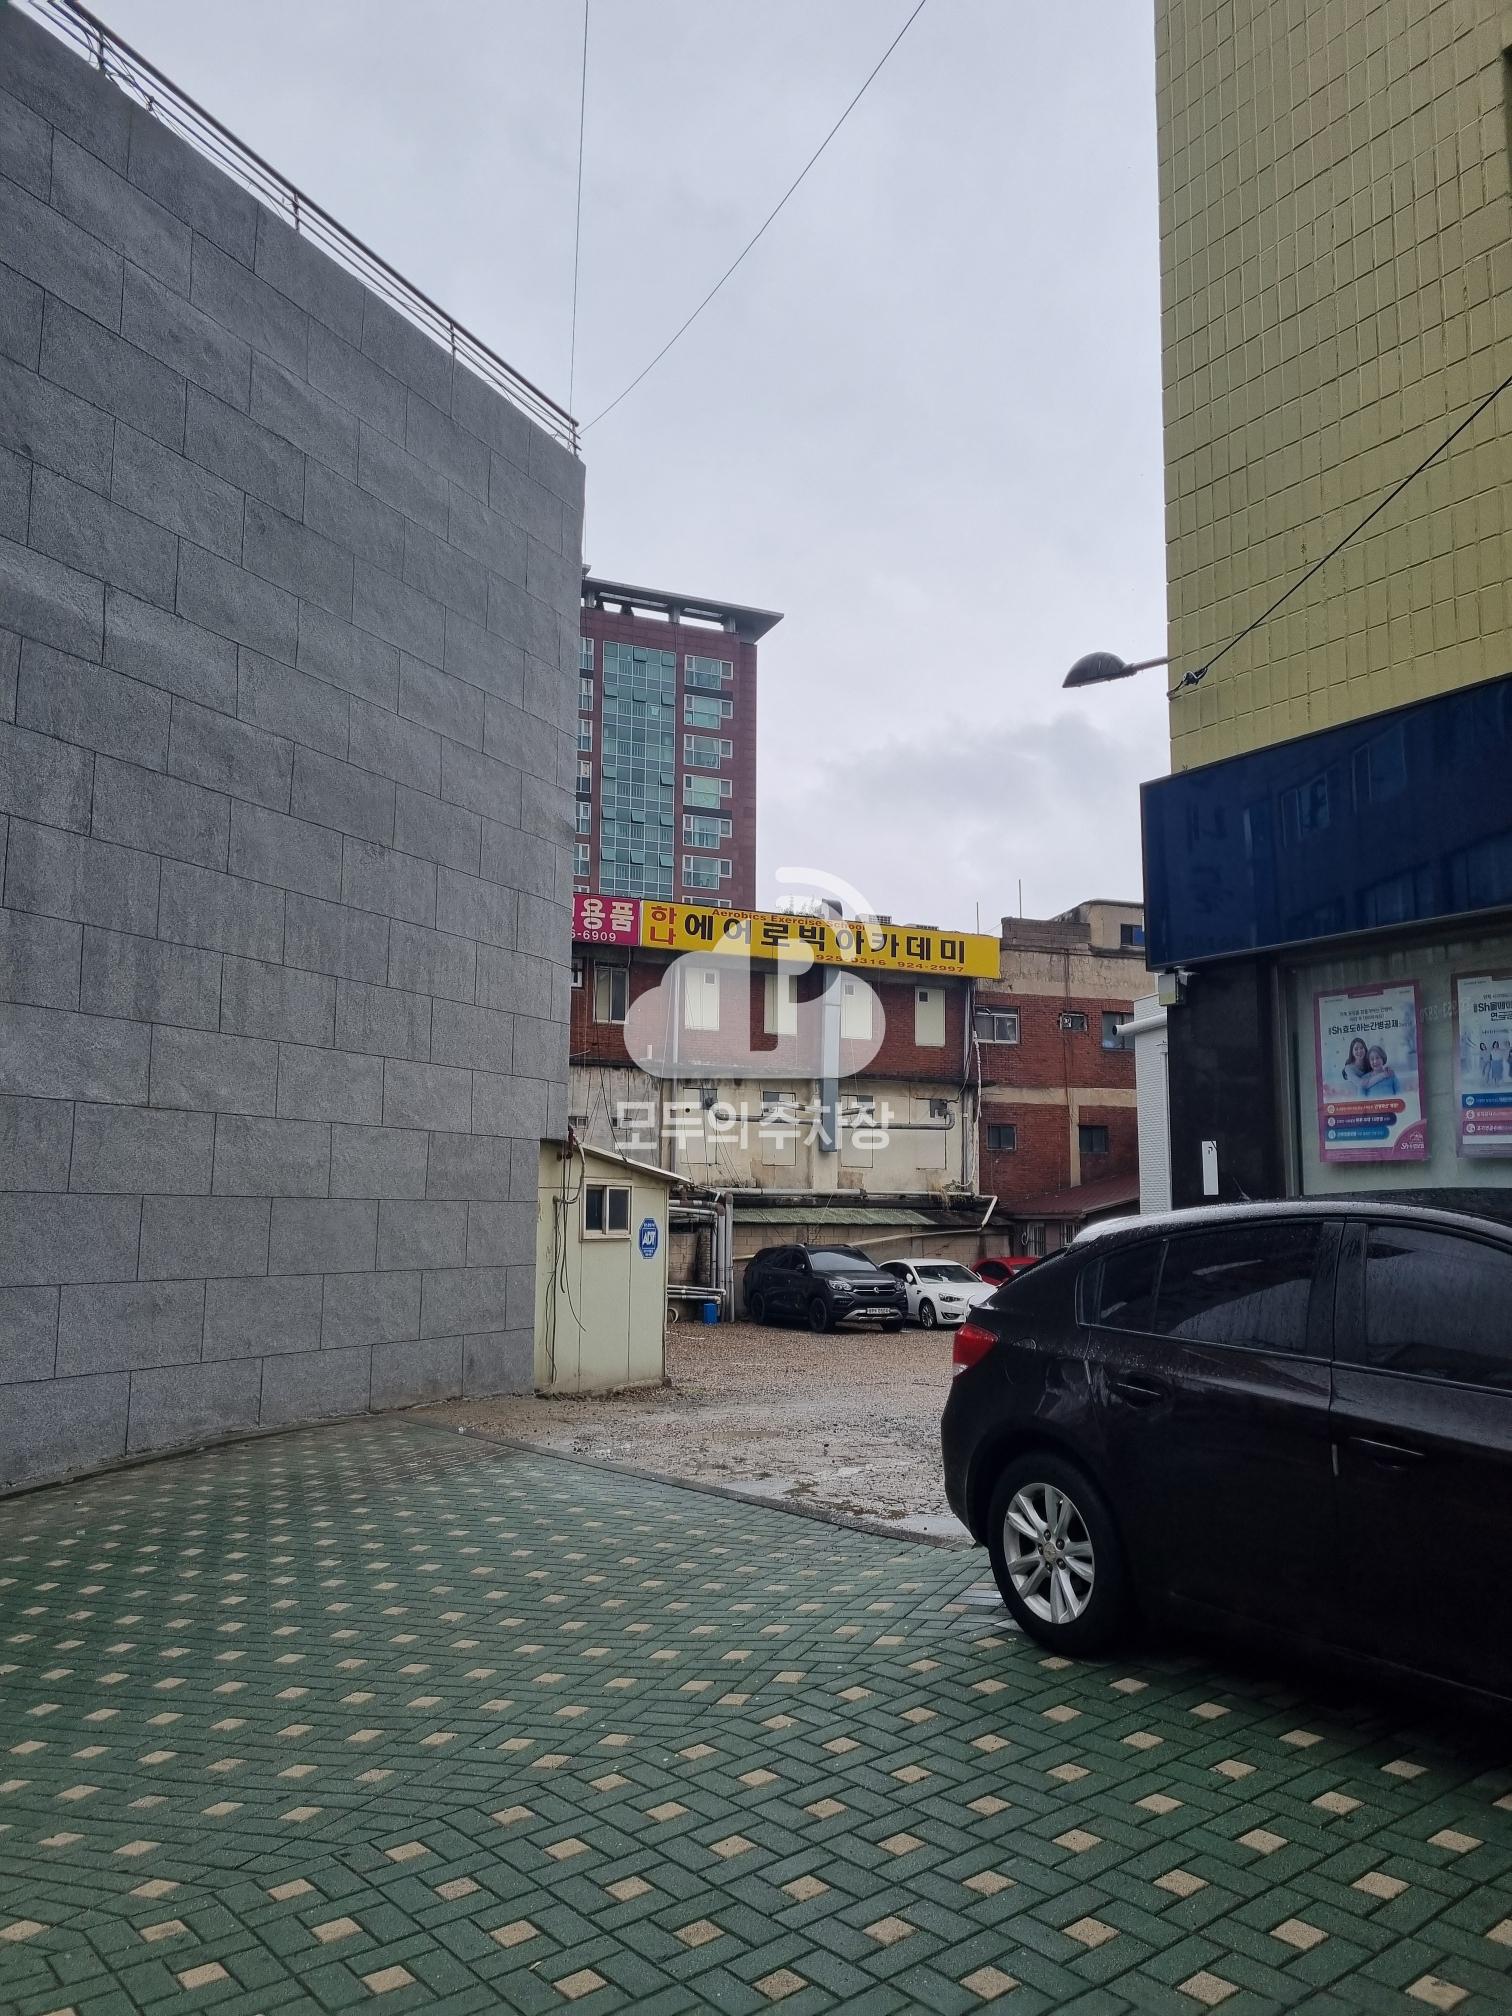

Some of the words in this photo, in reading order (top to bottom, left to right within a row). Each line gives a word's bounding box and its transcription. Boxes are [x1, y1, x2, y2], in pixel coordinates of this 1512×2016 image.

[573, 895, 635, 932] 용품
[649, 905, 677, 945] 하나
[711, 908, 768, 922] Aerobics
[770, 914, 823, 928] Exercise
[642, 1231, 656, 1245] ADT
